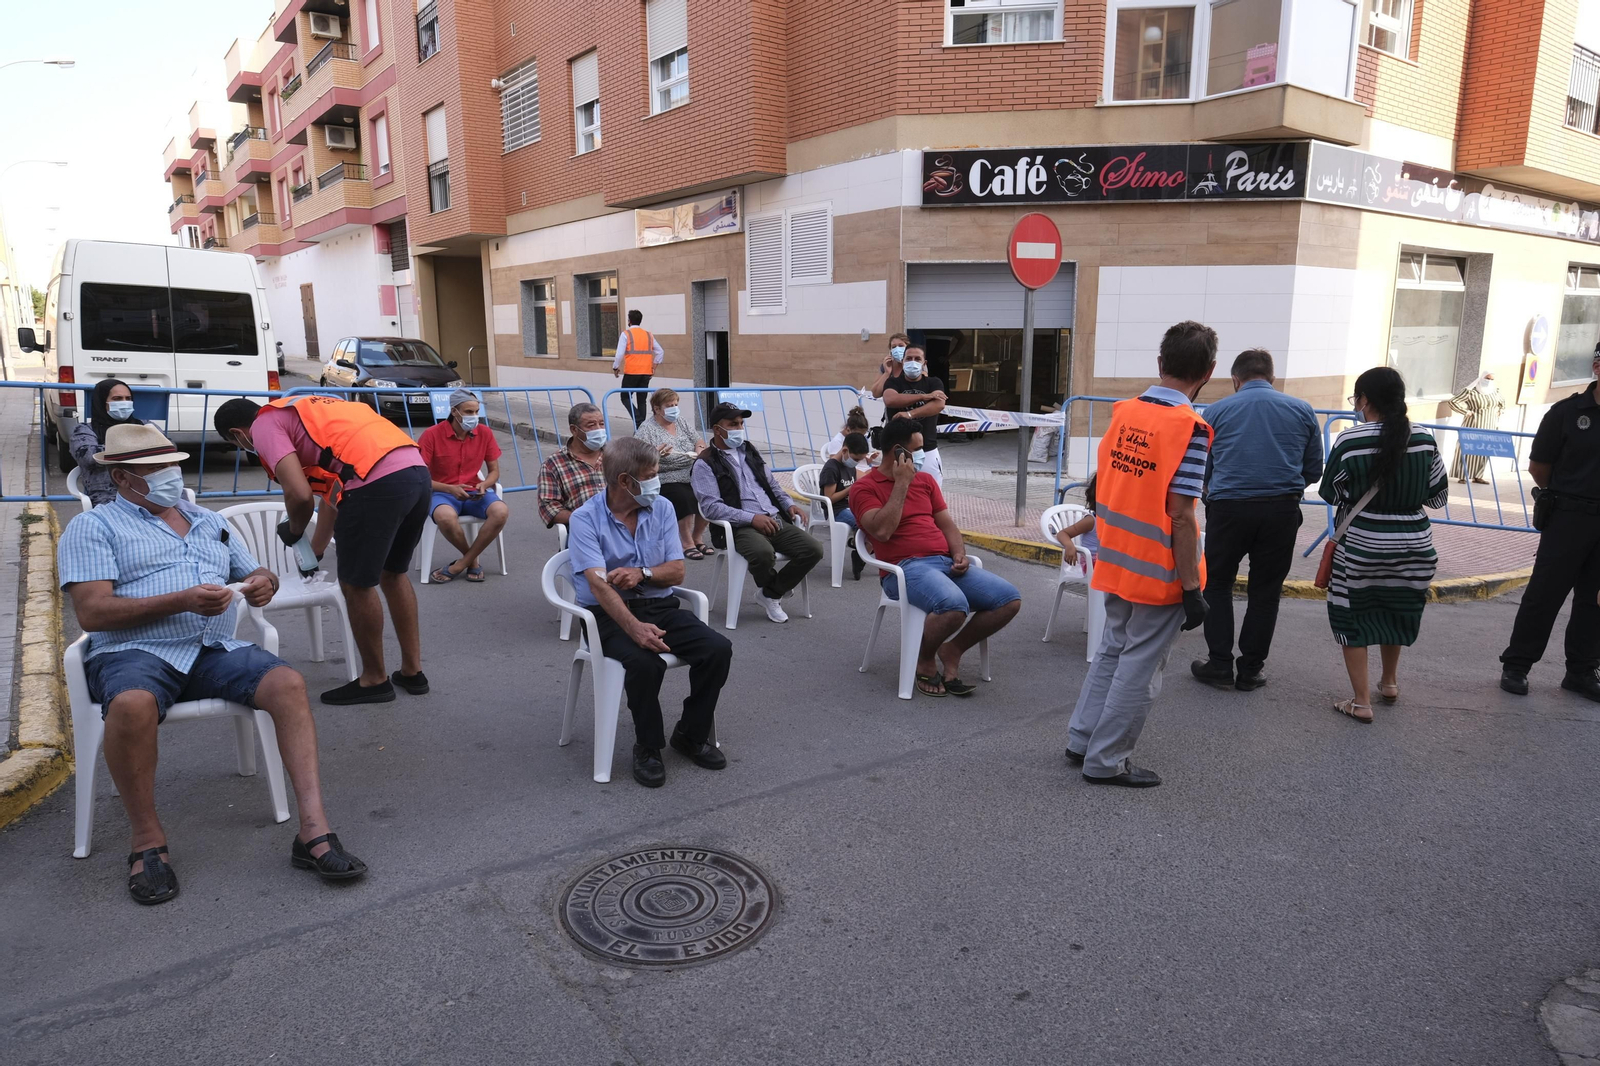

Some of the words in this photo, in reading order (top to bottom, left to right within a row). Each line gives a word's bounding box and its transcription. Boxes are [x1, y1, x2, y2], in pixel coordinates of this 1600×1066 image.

[968, 155, 1048, 197] Café
[1099, 151, 1187, 196] Simo
[1224, 150, 1296, 192] Paris
[1316, 167, 1345, 194] باريس
[1462, 433, 1512, 443] AYUNTAMIENTO
[570, 851, 708, 909] AYUNTAMIENTO
[599, 863, 719, 928] SANEAMIENTO
[652, 920, 717, 941] TUBOS
[716, 886, 737, 920] RUBIO
[606, 939, 639, 957] EL
[682, 922, 753, 957] EJIDO
